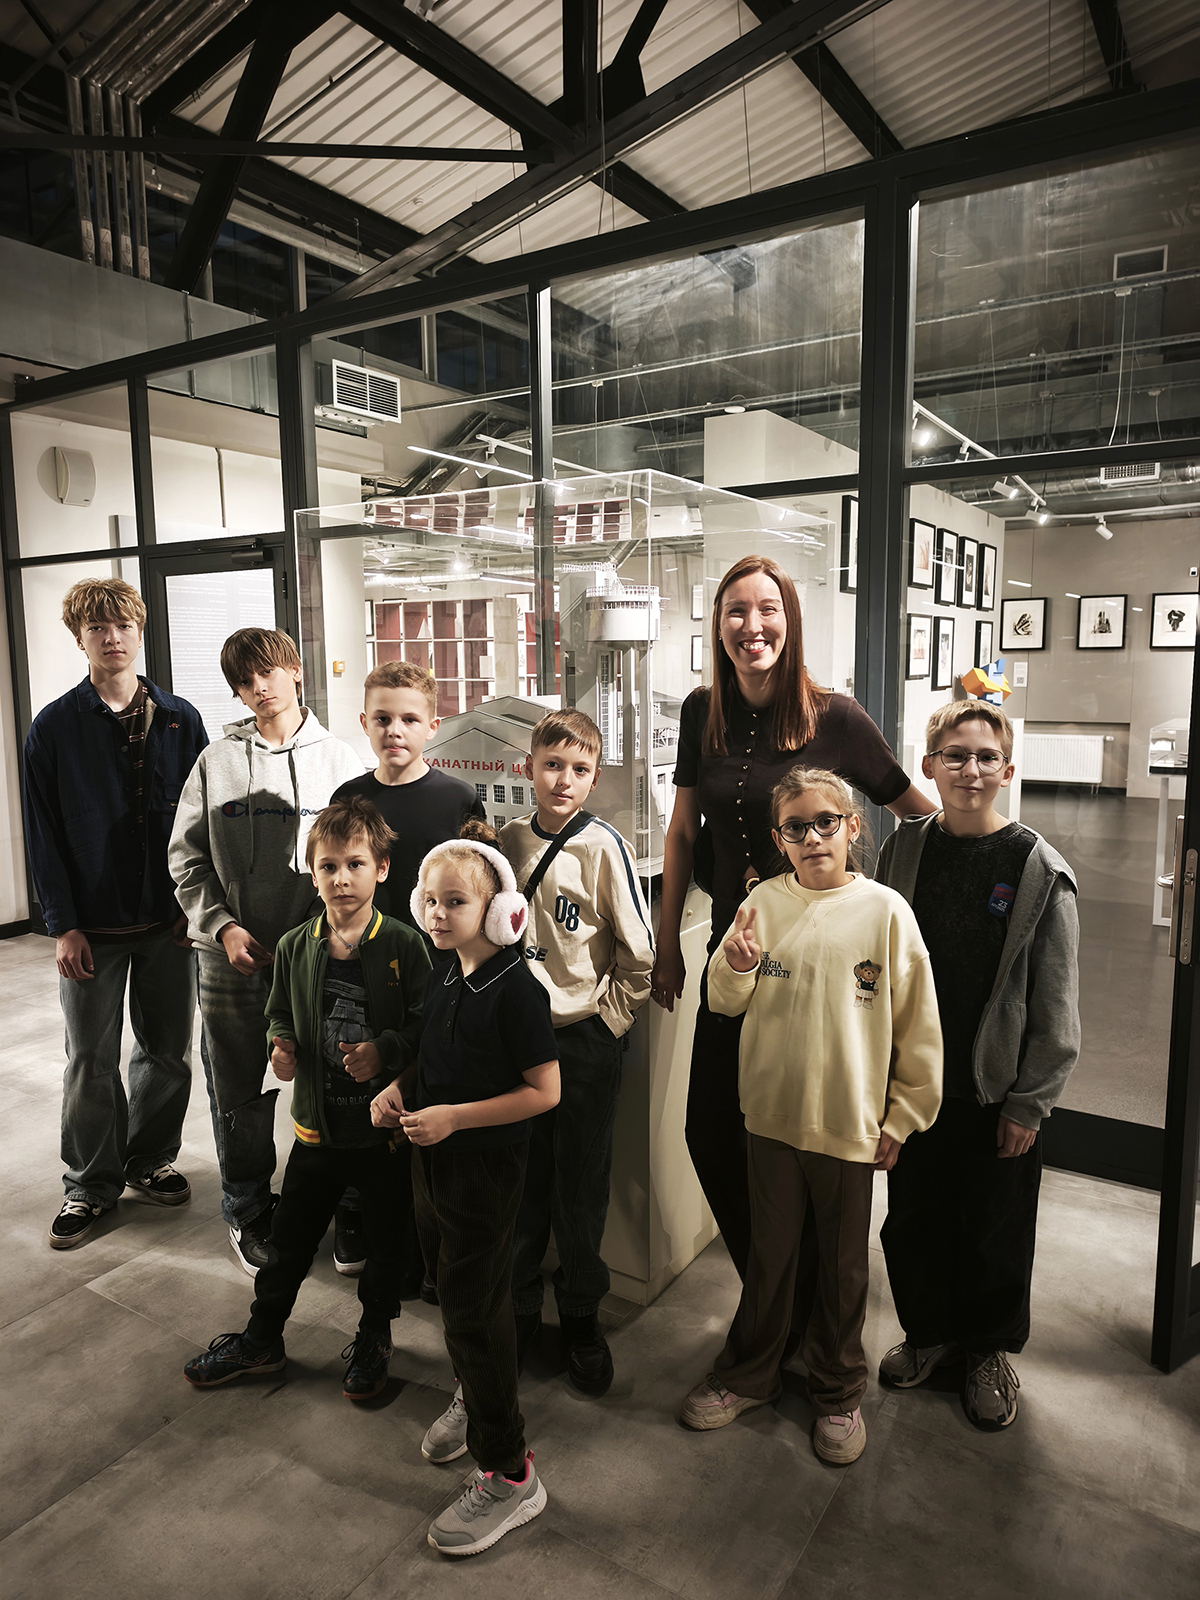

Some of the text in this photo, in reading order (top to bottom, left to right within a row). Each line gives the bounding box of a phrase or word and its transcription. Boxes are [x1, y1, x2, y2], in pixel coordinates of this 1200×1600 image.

[222, 800, 328, 823] Champon
[555, 894, 580, 932] 08
[761, 968, 791, 979] SOCIETY
[337, 1096, 348, 1106] ON
[349, 1095, 370, 1105] BLAC
